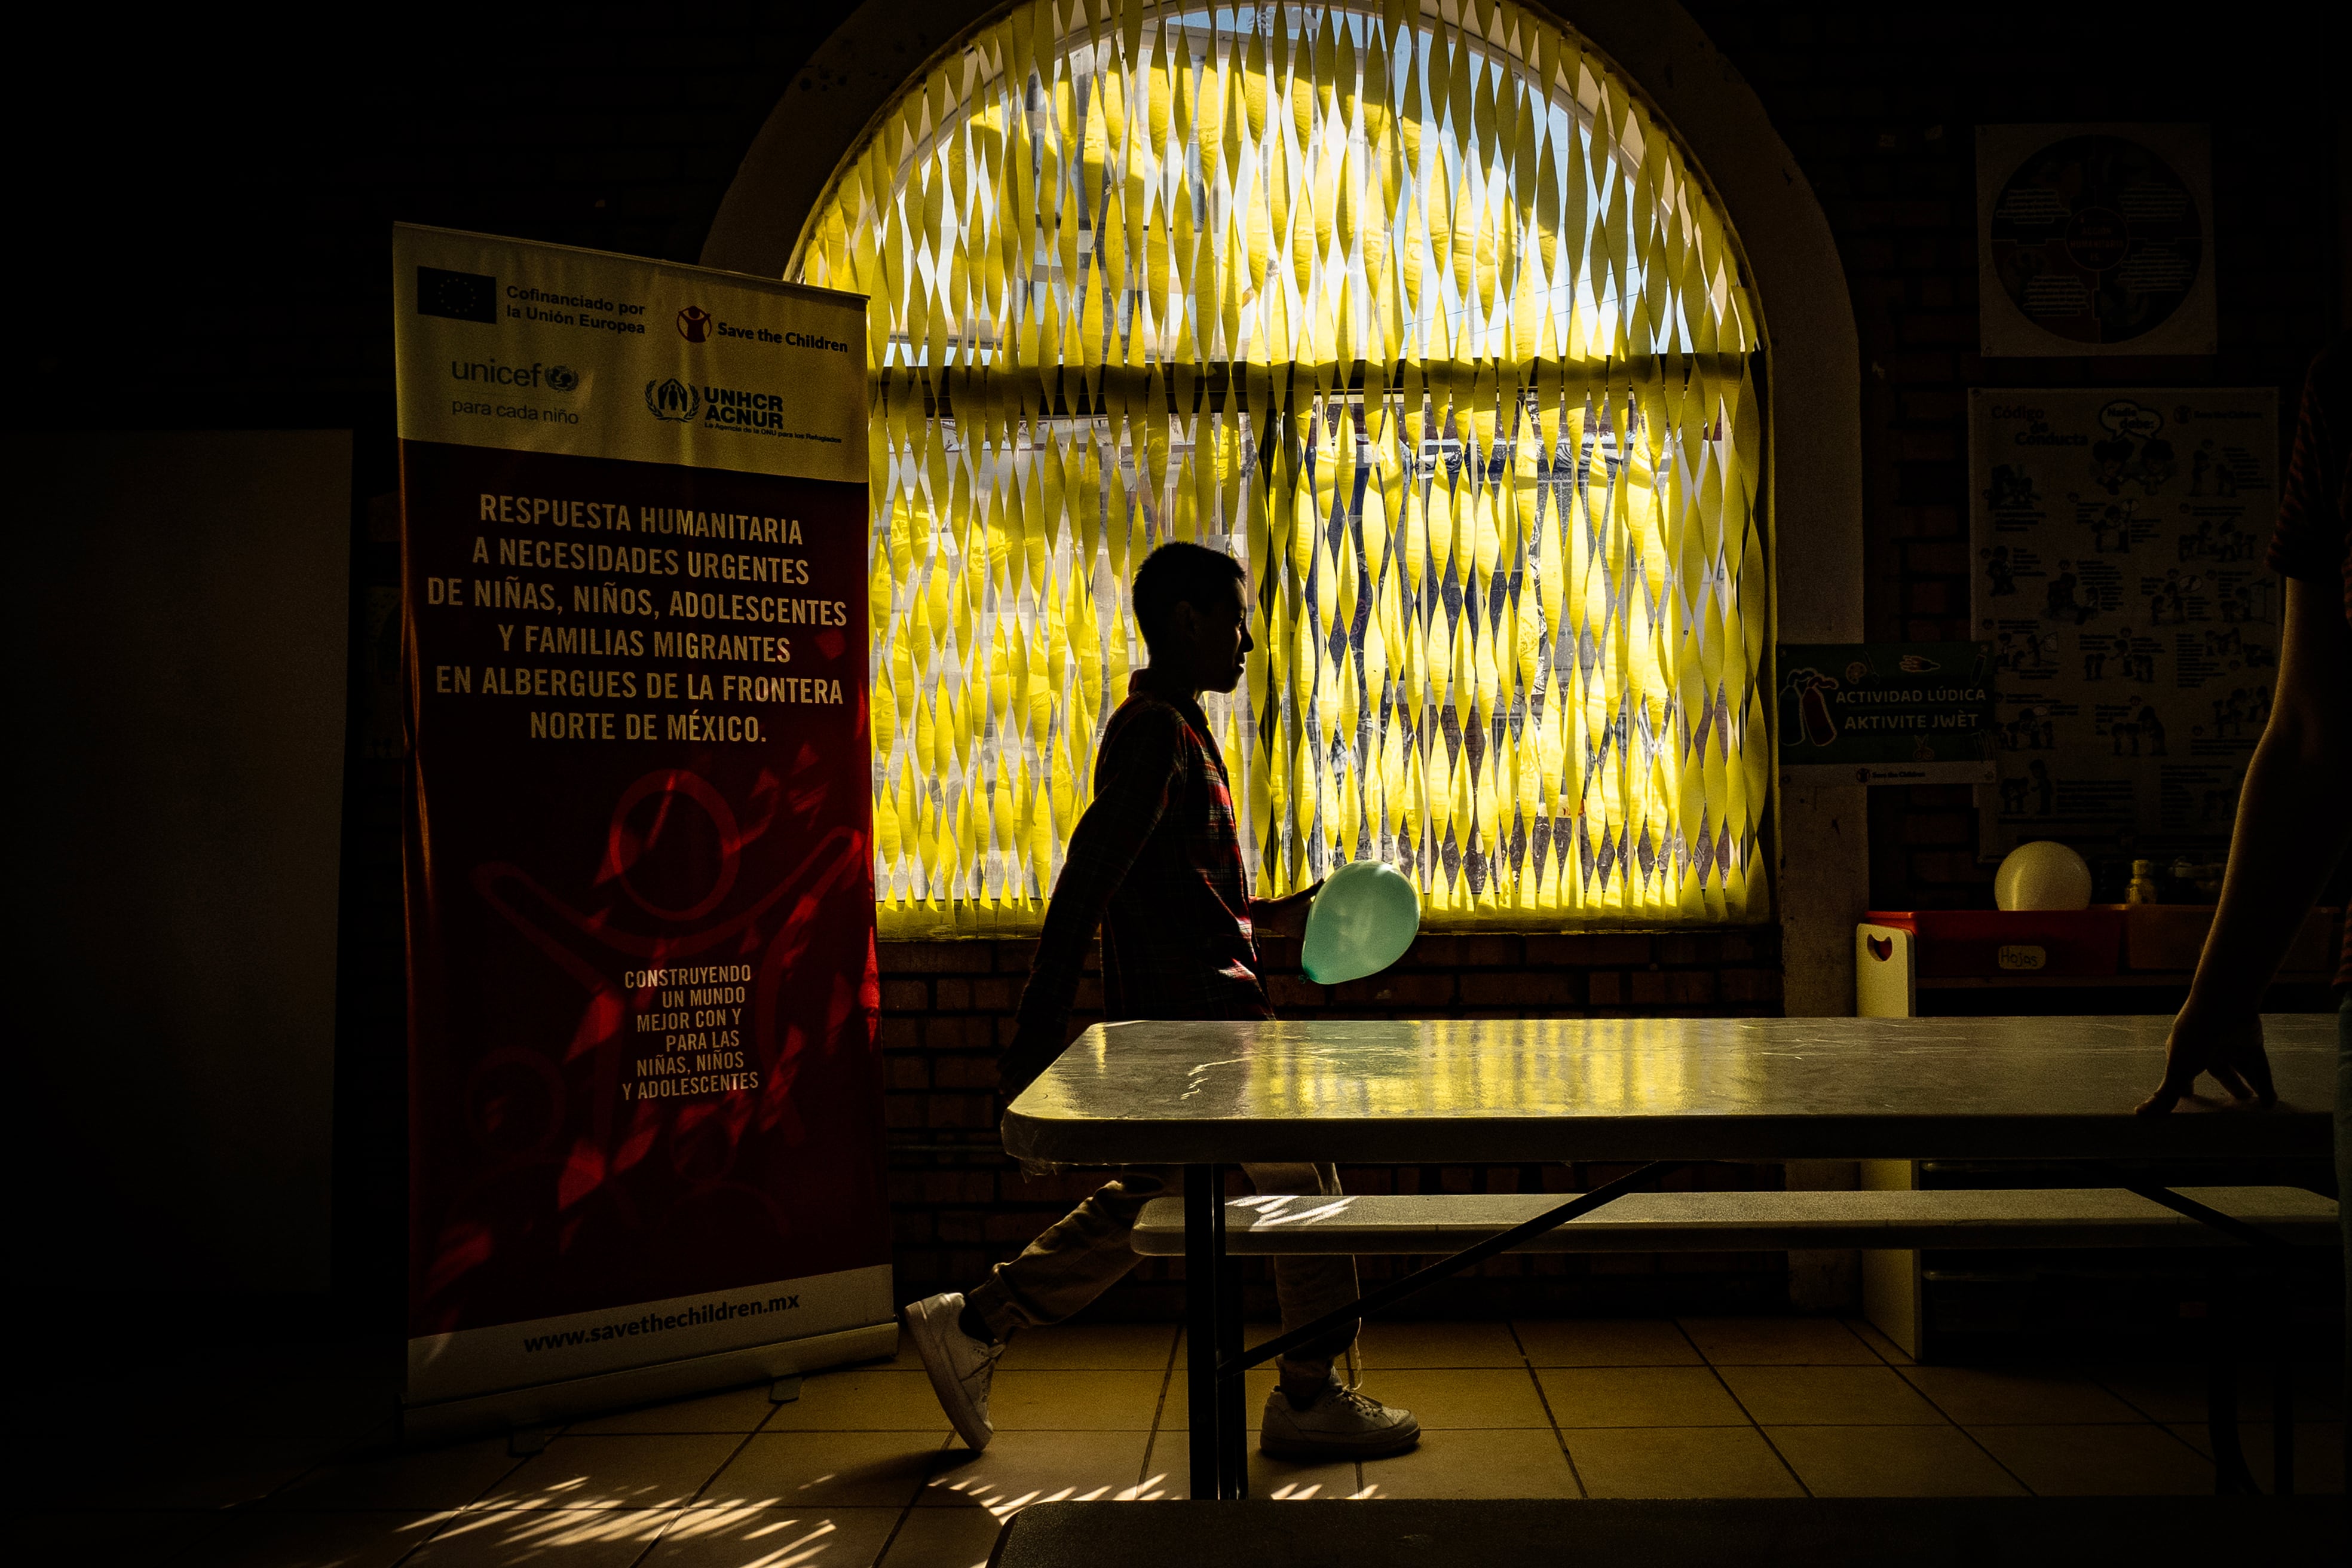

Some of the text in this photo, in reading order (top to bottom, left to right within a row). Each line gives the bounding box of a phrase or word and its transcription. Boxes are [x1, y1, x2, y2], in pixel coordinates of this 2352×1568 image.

[507, 286, 645, 316] Cofinanciado por
[507, 305, 645, 334] la Unión Europea
[718, 321, 847, 353] Save the Children
[452, 359, 541, 387] unicef
[452, 400, 578, 424] para cada niño
[705, 387, 783, 412] UNHCR
[705, 405, 783, 430] ACNUR
[1992, 405, 2045, 421] Código
[2107, 408, 2137, 417] Nadie
[2120, 416, 2155, 429] debe:
[715, 423, 742, 432] Agencia
[806, 433, 842, 443] Refugiados
[2014, 431, 2089, 446] Conducta
[2030, 420, 2048, 434] de
[480, 494, 803, 545] RESPUESTA HUMANITARIA
[472, 536, 808, 585] A NECESIDADES URGENTES
[427, 575, 847, 626] DE NIÑAS, NIÑOS, ADOLESCENTES
[498, 624, 791, 663] Y FAMILIAS MIGRANTES
[436, 665, 844, 705] EN ALBERGUES DE LA FRONTERA
[1835, 685, 1987, 703] ACTIVIDAD LÚDICA
[530, 709, 767, 743] NORTE DE MÉXICO.
[1844, 709, 1979, 730] AKTIVITE JWÈT
[2001, 947, 2038, 967] Hojas
[624, 964, 751, 989] CONSTRUYENDO
[662, 986, 746, 1009] UN MUNDO
[636, 1007, 742, 1033] MEJOR CON Y
[666, 1030, 740, 1052] PARA LAS
[636, 1049, 745, 1077] NIÑAS, NIÑOS
[621, 1071, 759, 1101] Y ADOLESCENTES
[523, 1294, 800, 1353] www.savethechildren.mx
